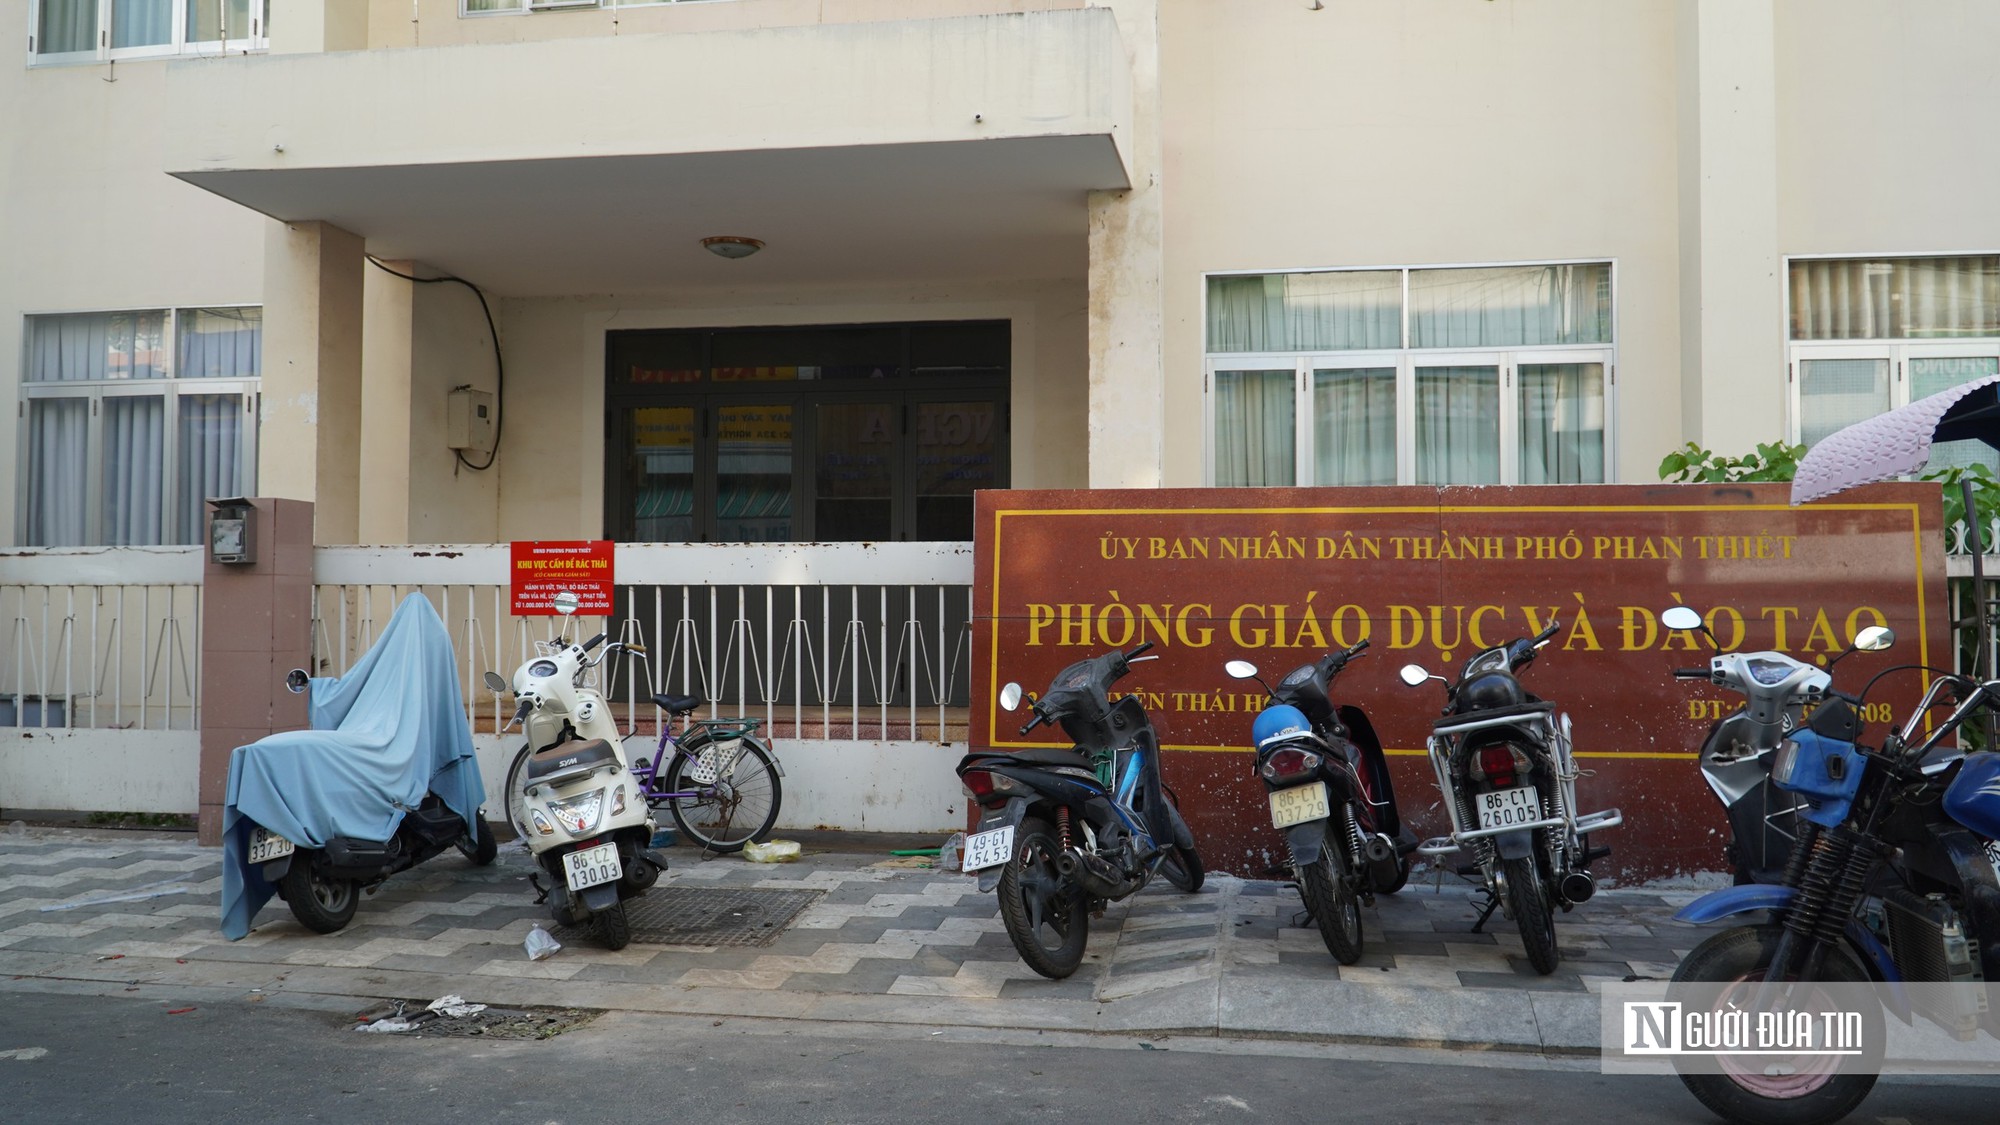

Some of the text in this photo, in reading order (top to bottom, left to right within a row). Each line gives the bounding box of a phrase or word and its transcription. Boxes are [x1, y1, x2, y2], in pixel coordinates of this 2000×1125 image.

[1099, 529, 1798, 561] ỦY BAN NHÂN DÂN THÀNH PHỐ PHAN THIẾT
[517, 560, 532, 569] KHU
[575, 558, 590, 569] RÁC
[1025, 590, 1888, 666] PHÒNG GIÁO DỤC VÀ ĐÀO TẠO
[1172, 688, 1236, 712] THÁI
[559, 757, 578, 768] SYM
[1279, 785, 1317, 808] 86-C1
[1276, 800, 1326, 826] 037.29
[1483, 804, 1537, 828] 260.05
[973, 830, 1006, 851] 49-G1
[572, 847, 610, 871] 86-C2
[571, 862, 618, 888] 130.03
